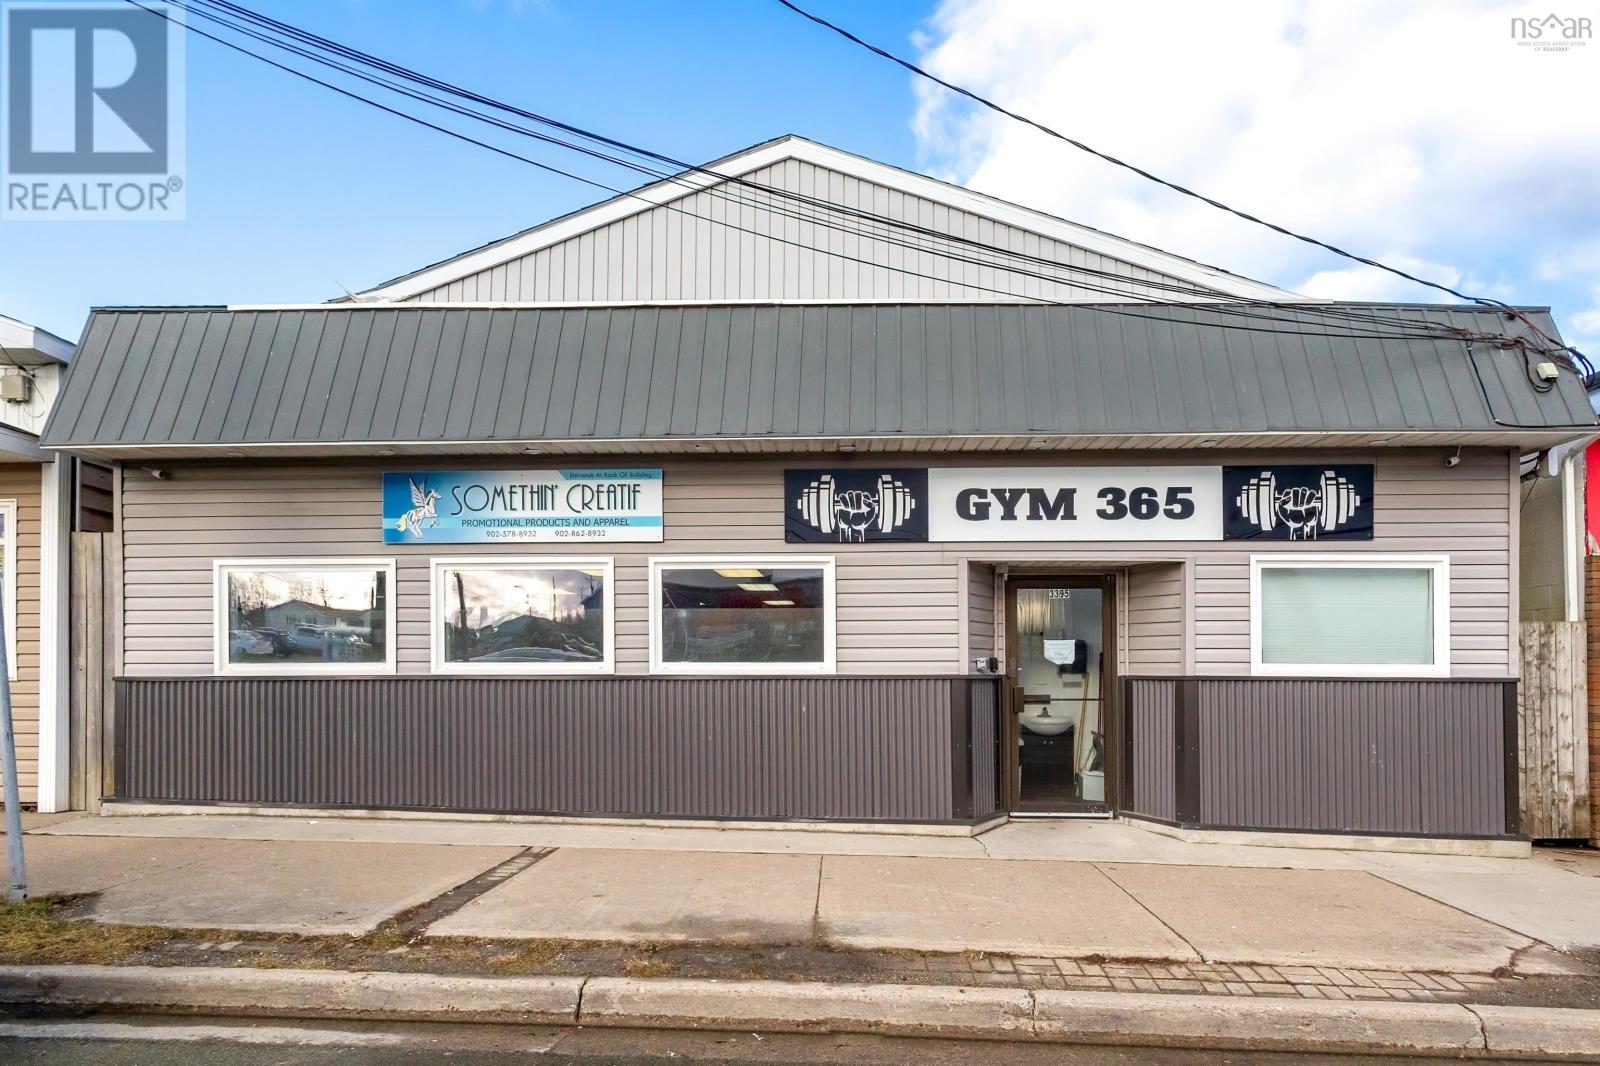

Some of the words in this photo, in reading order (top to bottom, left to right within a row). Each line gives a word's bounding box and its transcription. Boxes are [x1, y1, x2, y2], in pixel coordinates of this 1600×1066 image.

[451, 484, 559, 515] SOMETHIN'
[566, 483, 641, 514] CREATIF
[955, 487, 1078, 521] GYM
[1096, 486, 1195, 520] 365
[461, 519, 523, 527] PROMOTIONAL
[525, 518, 571, 527] PRODUCTS
[573, 518, 590, 526] AND
[593, 518, 630, 526] APPAREL
[486, 530, 537, 538] 902-578-8932
[554, 529, 606, 537] 902-862-8932
[1049, 589, 1070, 599] 3395
